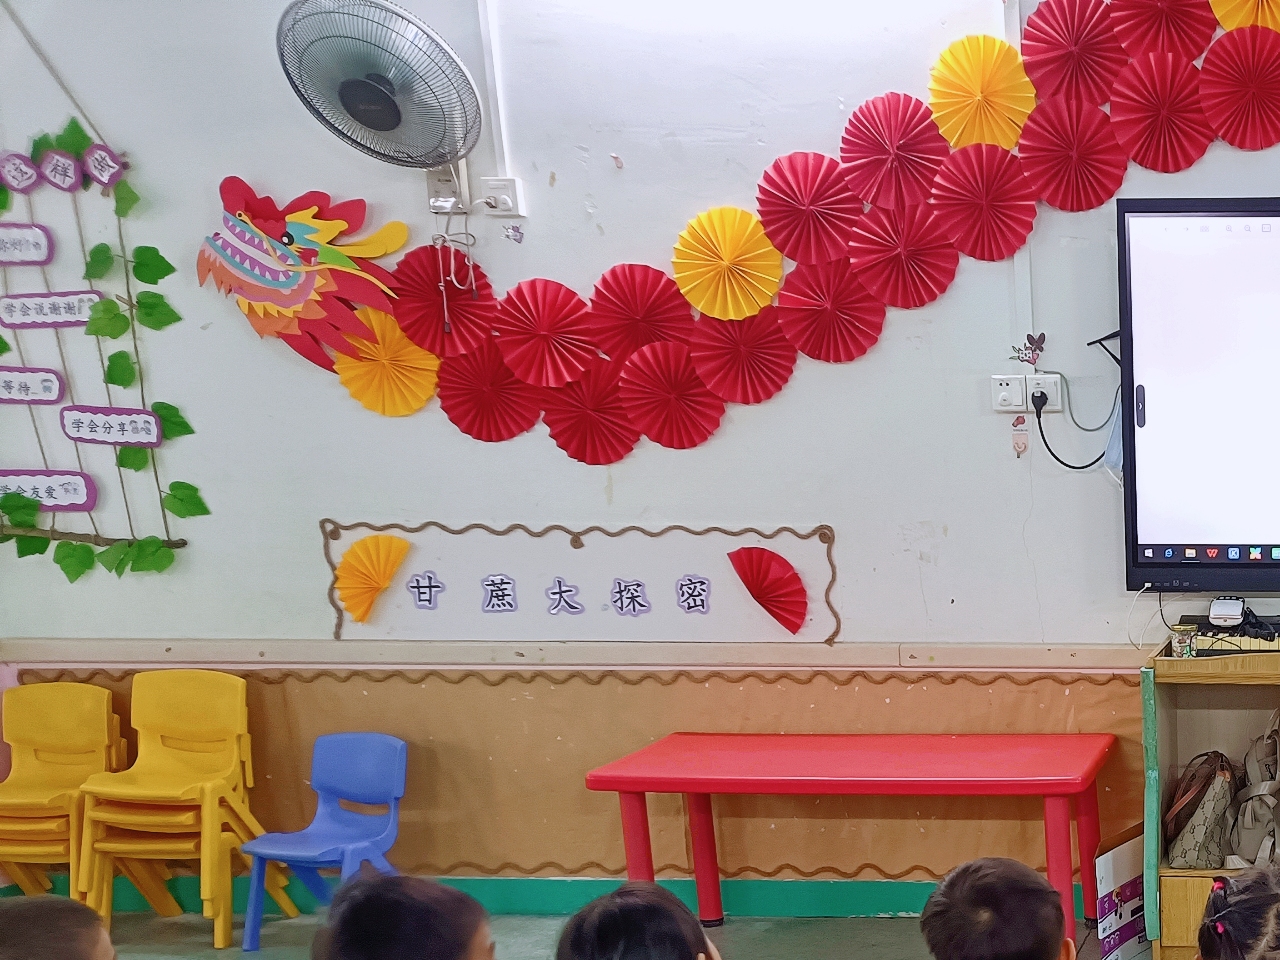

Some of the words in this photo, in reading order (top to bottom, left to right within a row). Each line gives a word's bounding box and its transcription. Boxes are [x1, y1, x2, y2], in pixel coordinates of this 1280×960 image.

[71, 418, 129, 436] 学会分享
[409, 575, 708, 612] 甘蔗大探密
